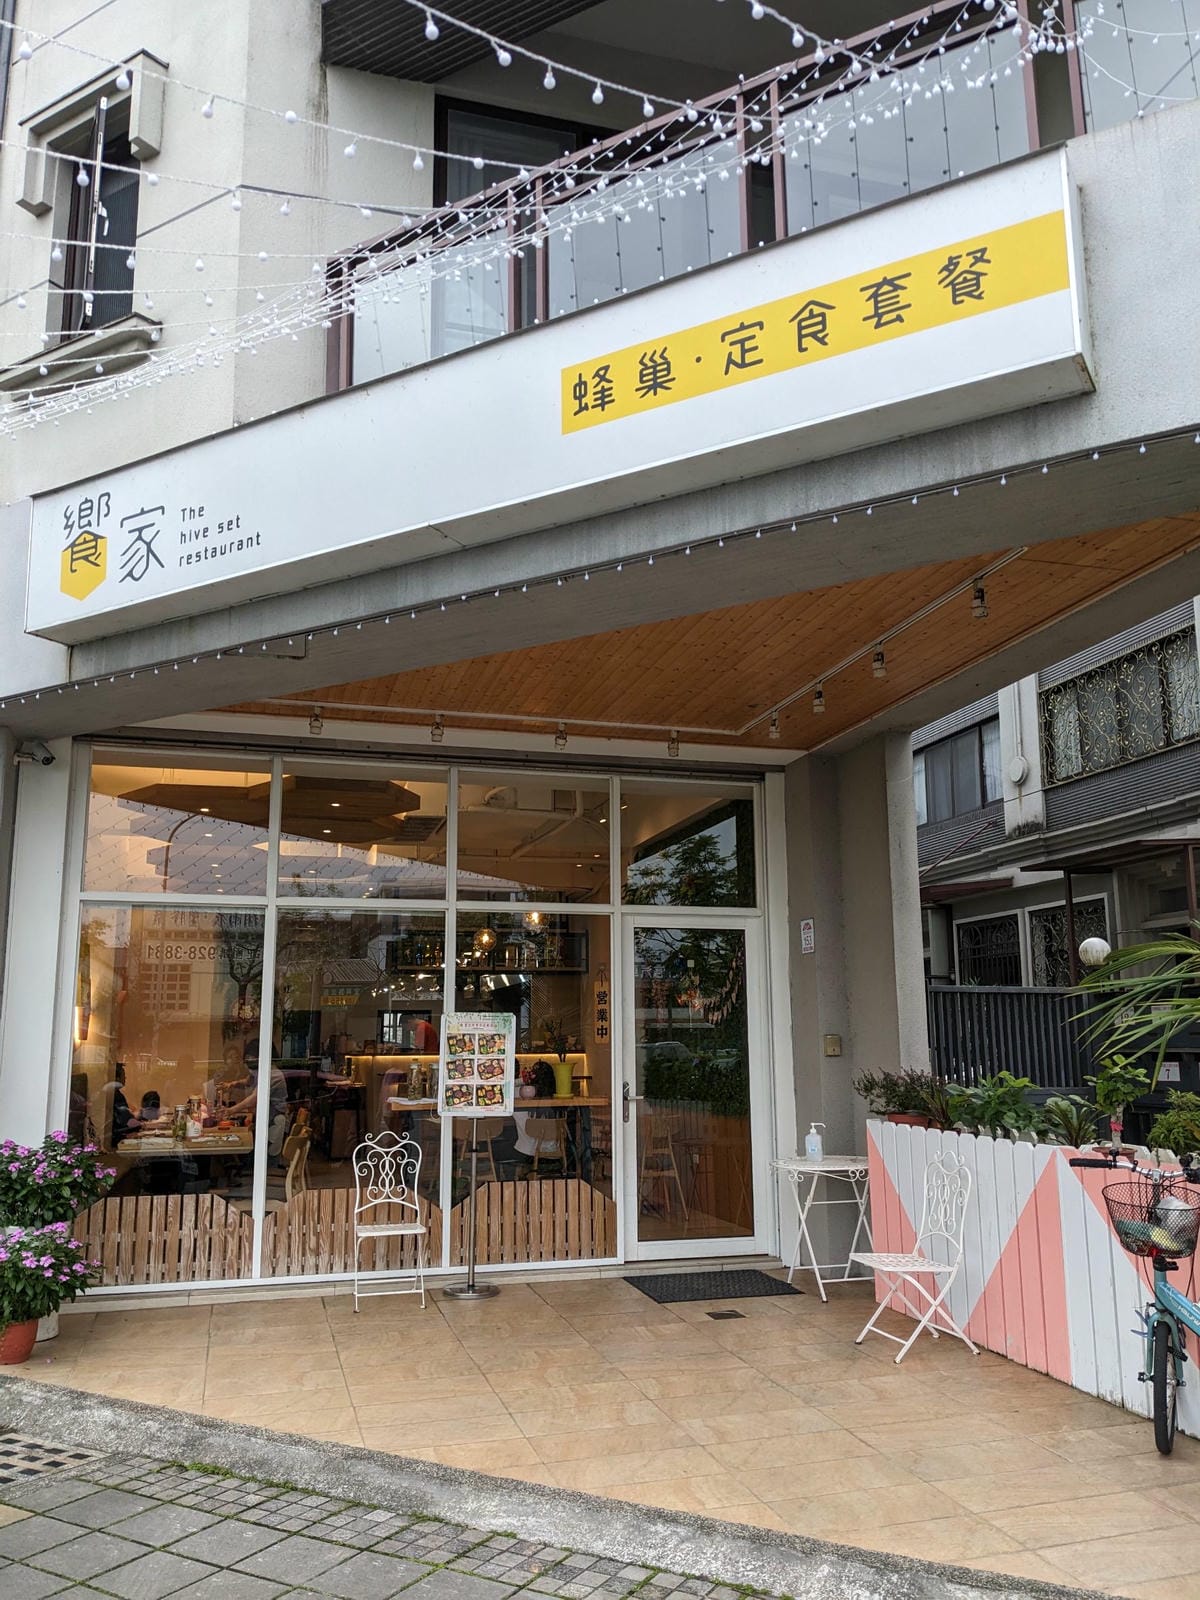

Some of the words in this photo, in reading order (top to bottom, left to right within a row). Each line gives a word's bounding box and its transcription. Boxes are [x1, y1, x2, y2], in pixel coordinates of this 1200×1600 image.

[180, 526, 209, 545] hive
[217, 514, 241, 534] set
[181, 506, 204, 522] The
[63, 492, 165, 583] 饗家
[179, 531, 261, 567] restaurant
[1165, 1068, 1171, 1080] 7
